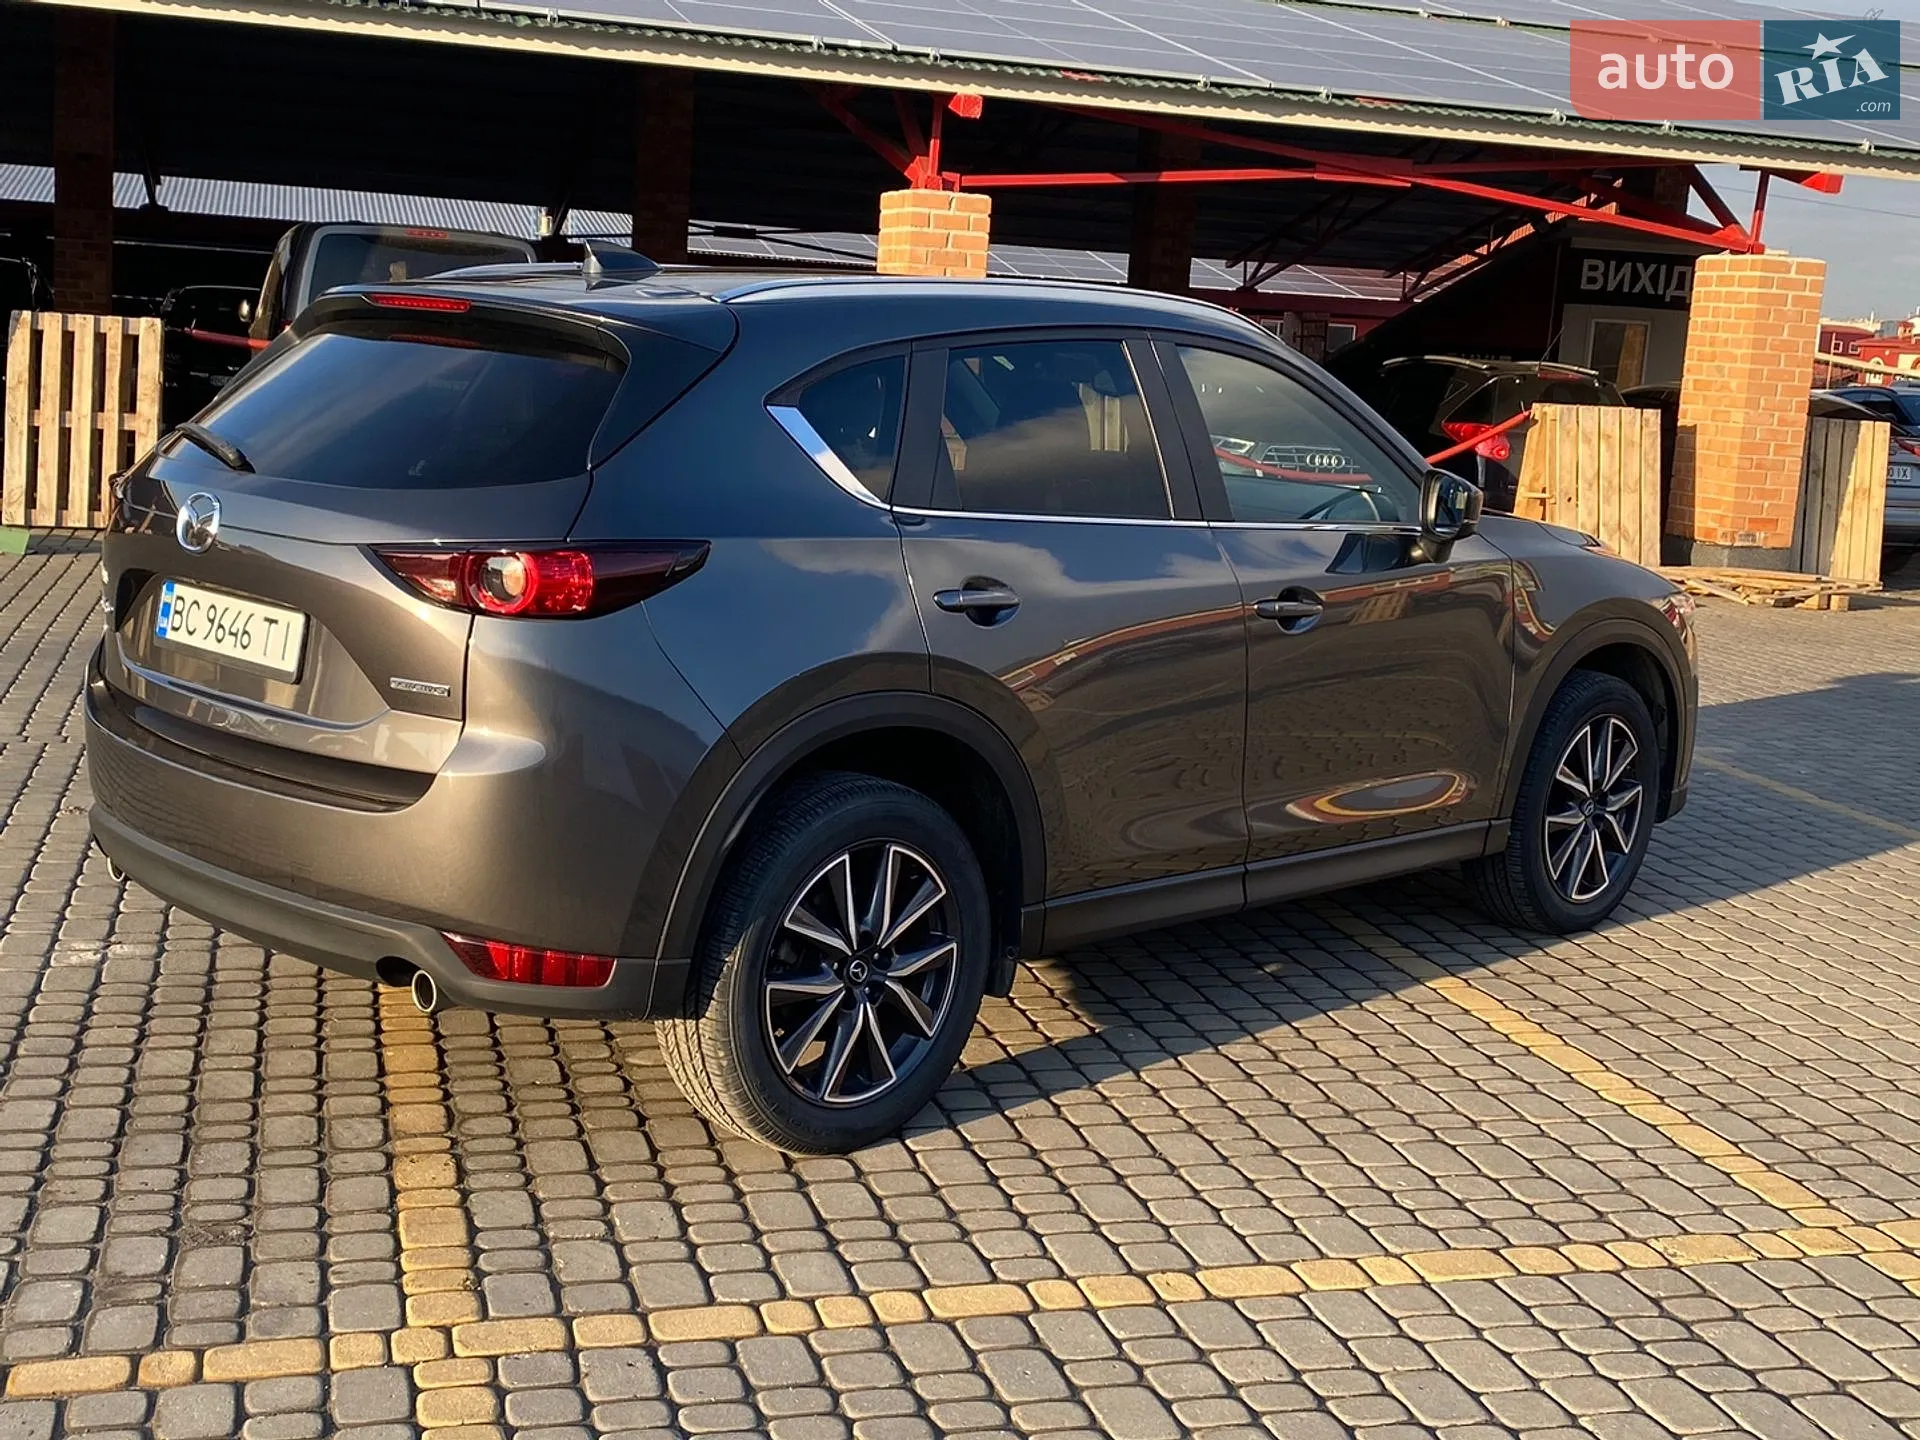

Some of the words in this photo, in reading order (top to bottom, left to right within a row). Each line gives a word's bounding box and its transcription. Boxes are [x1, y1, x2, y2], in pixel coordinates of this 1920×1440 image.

[1580, 258, 1692, 304] ВИХІД
[170, 596, 201, 636] BC
[203, 604, 256, 650] 9646
